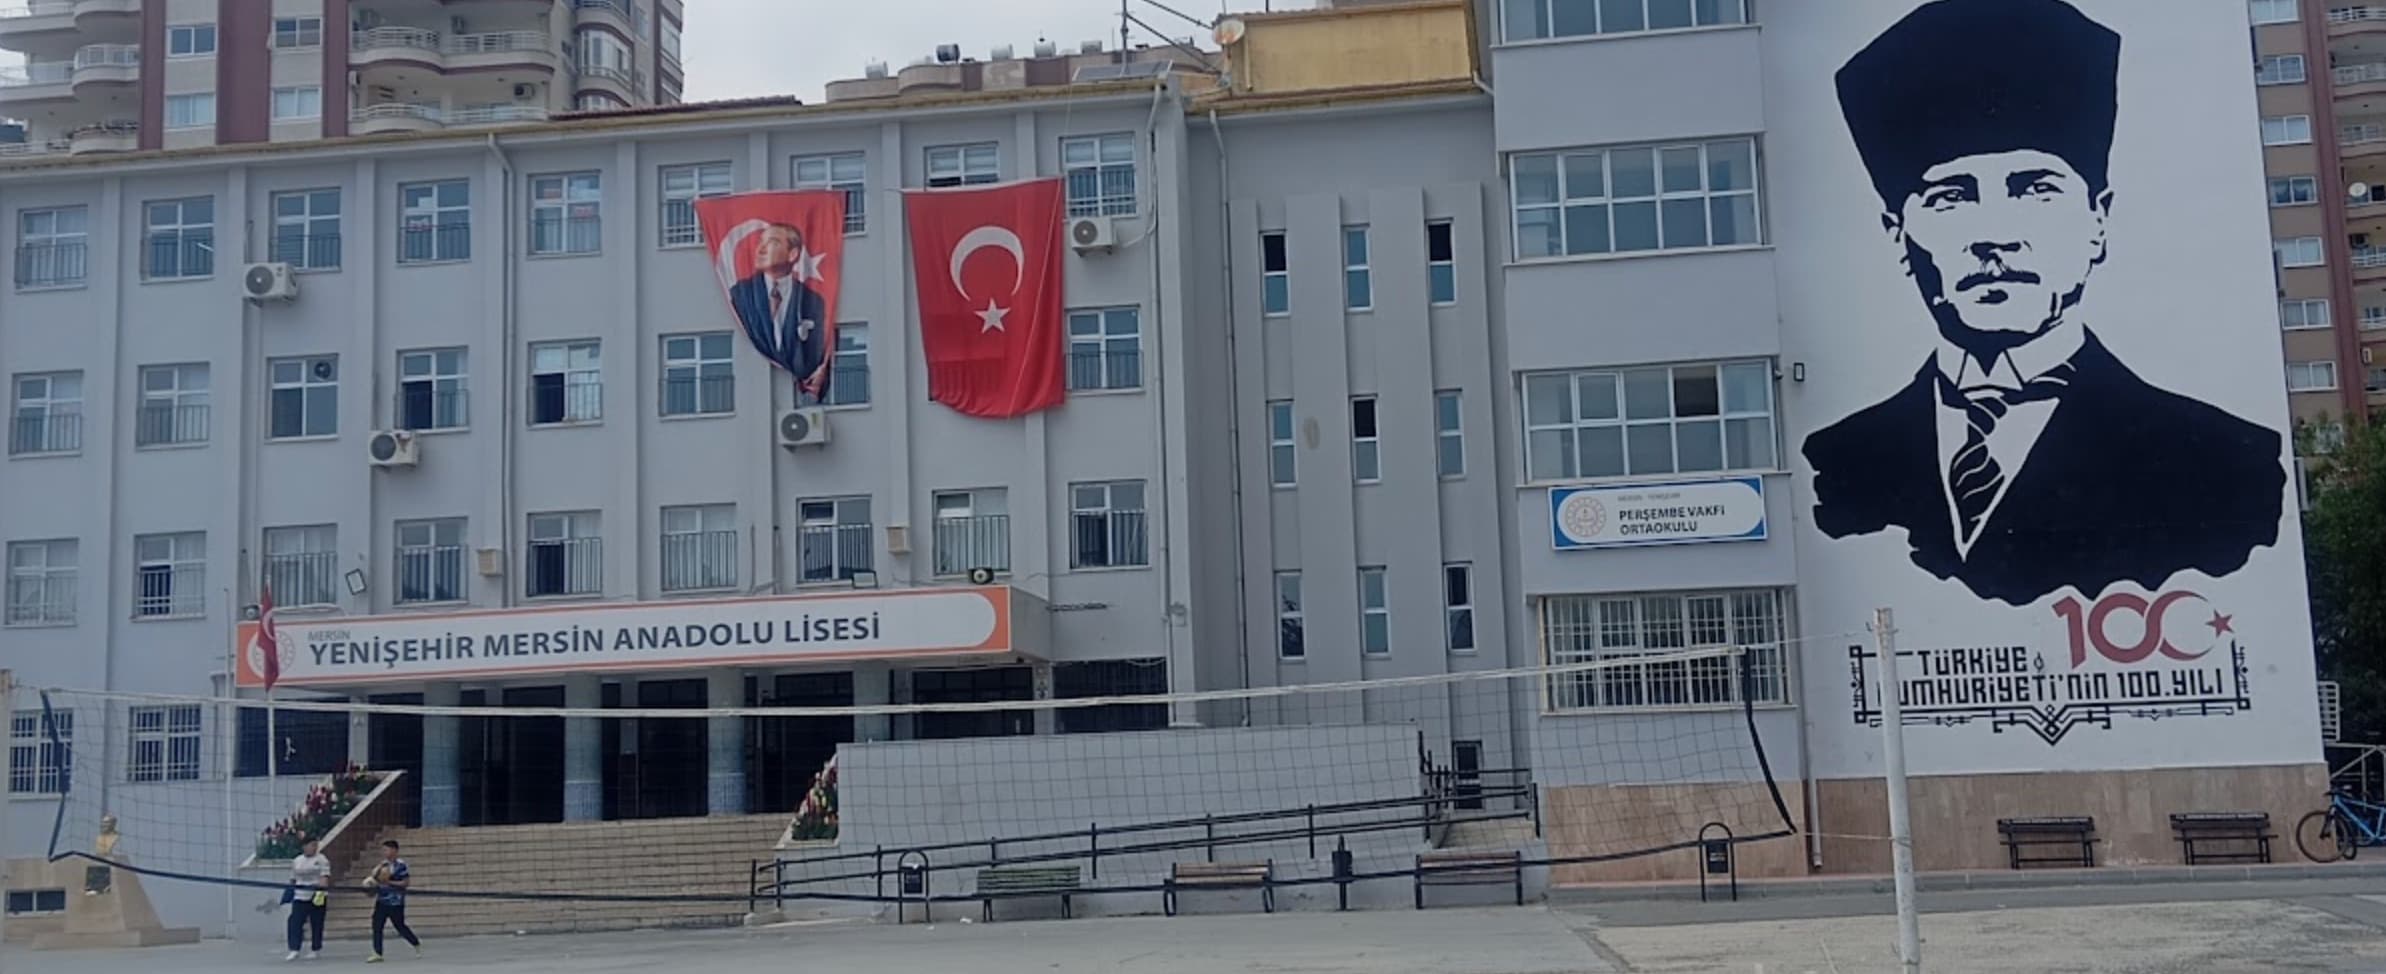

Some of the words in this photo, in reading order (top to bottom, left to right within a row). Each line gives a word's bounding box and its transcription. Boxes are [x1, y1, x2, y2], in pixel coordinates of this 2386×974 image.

[1619, 507, 1686, 521] PERŞEMBE
[1620, 522, 1697, 535] ORTAOKULU
[309, 632, 474, 669] YENİŞEHİR
[484, 624, 603, 656] MERSİN
[613, 619, 774, 651] ANADOLU
[785, 611, 880, 643] LİSESİ
[2052, 590, 2214, 670] 100
